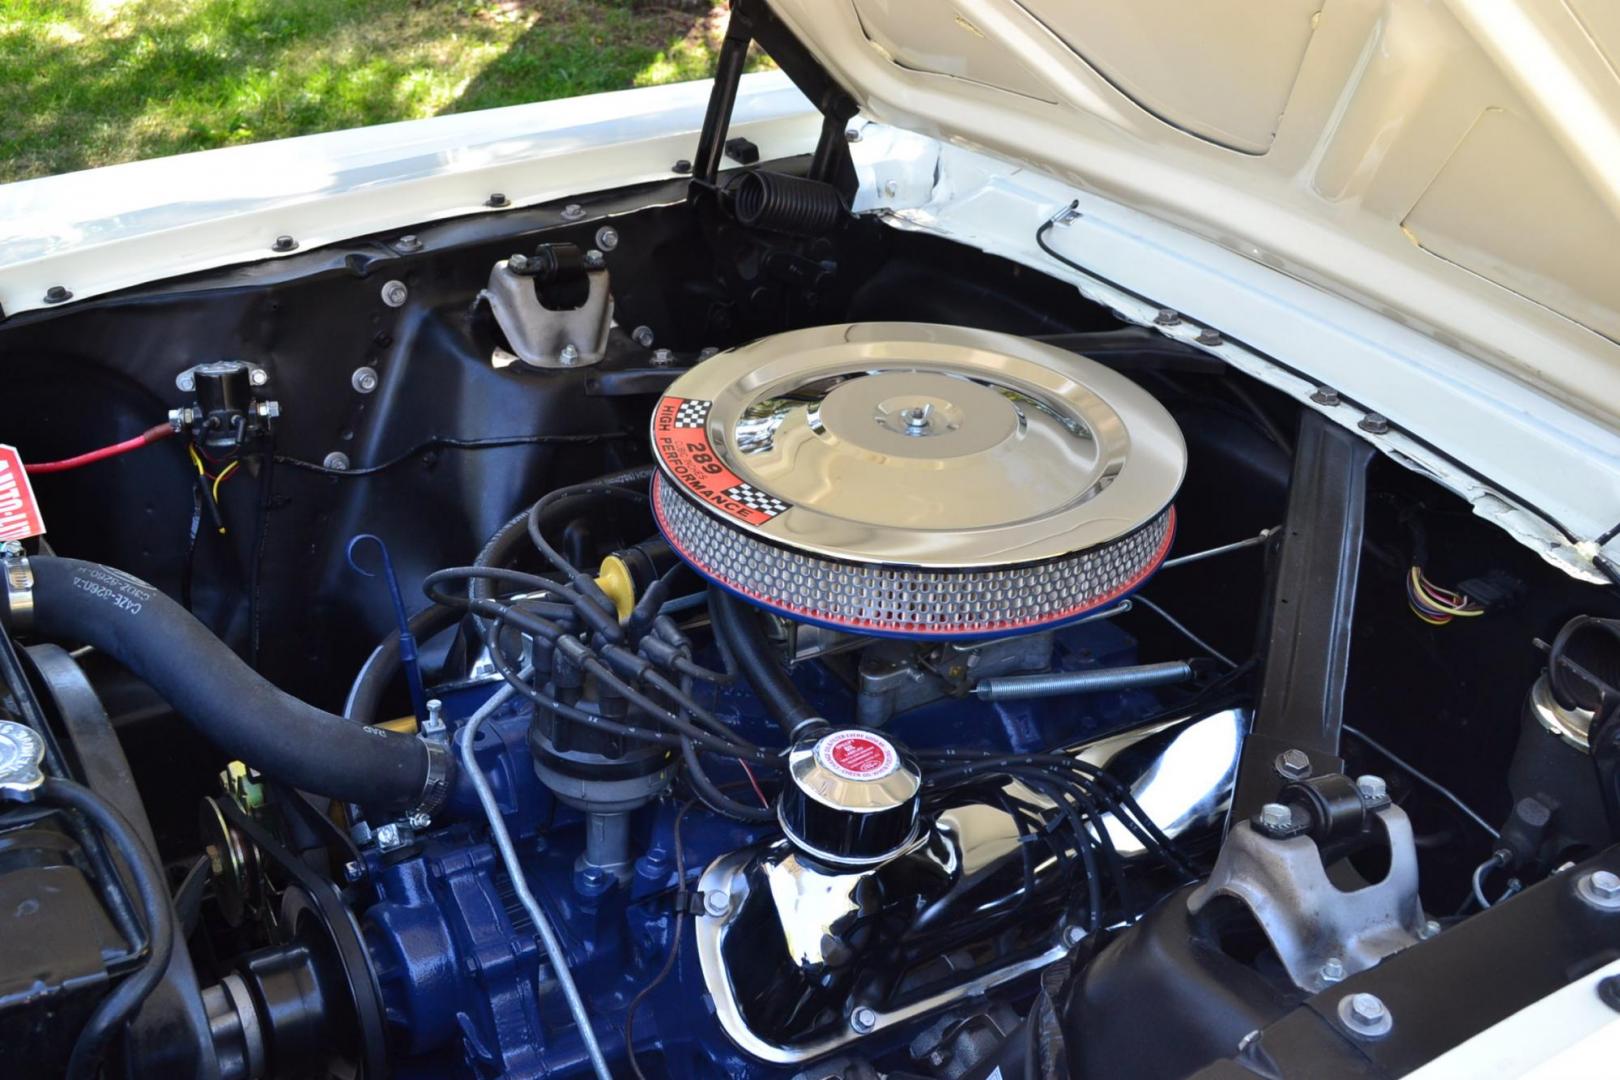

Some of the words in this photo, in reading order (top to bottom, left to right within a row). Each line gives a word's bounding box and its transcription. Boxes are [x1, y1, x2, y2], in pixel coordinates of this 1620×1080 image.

[659, 405, 675, 431] HIGH
[686, 442, 723, 475] 289
[659, 437, 753, 518] PERFORMANCE
